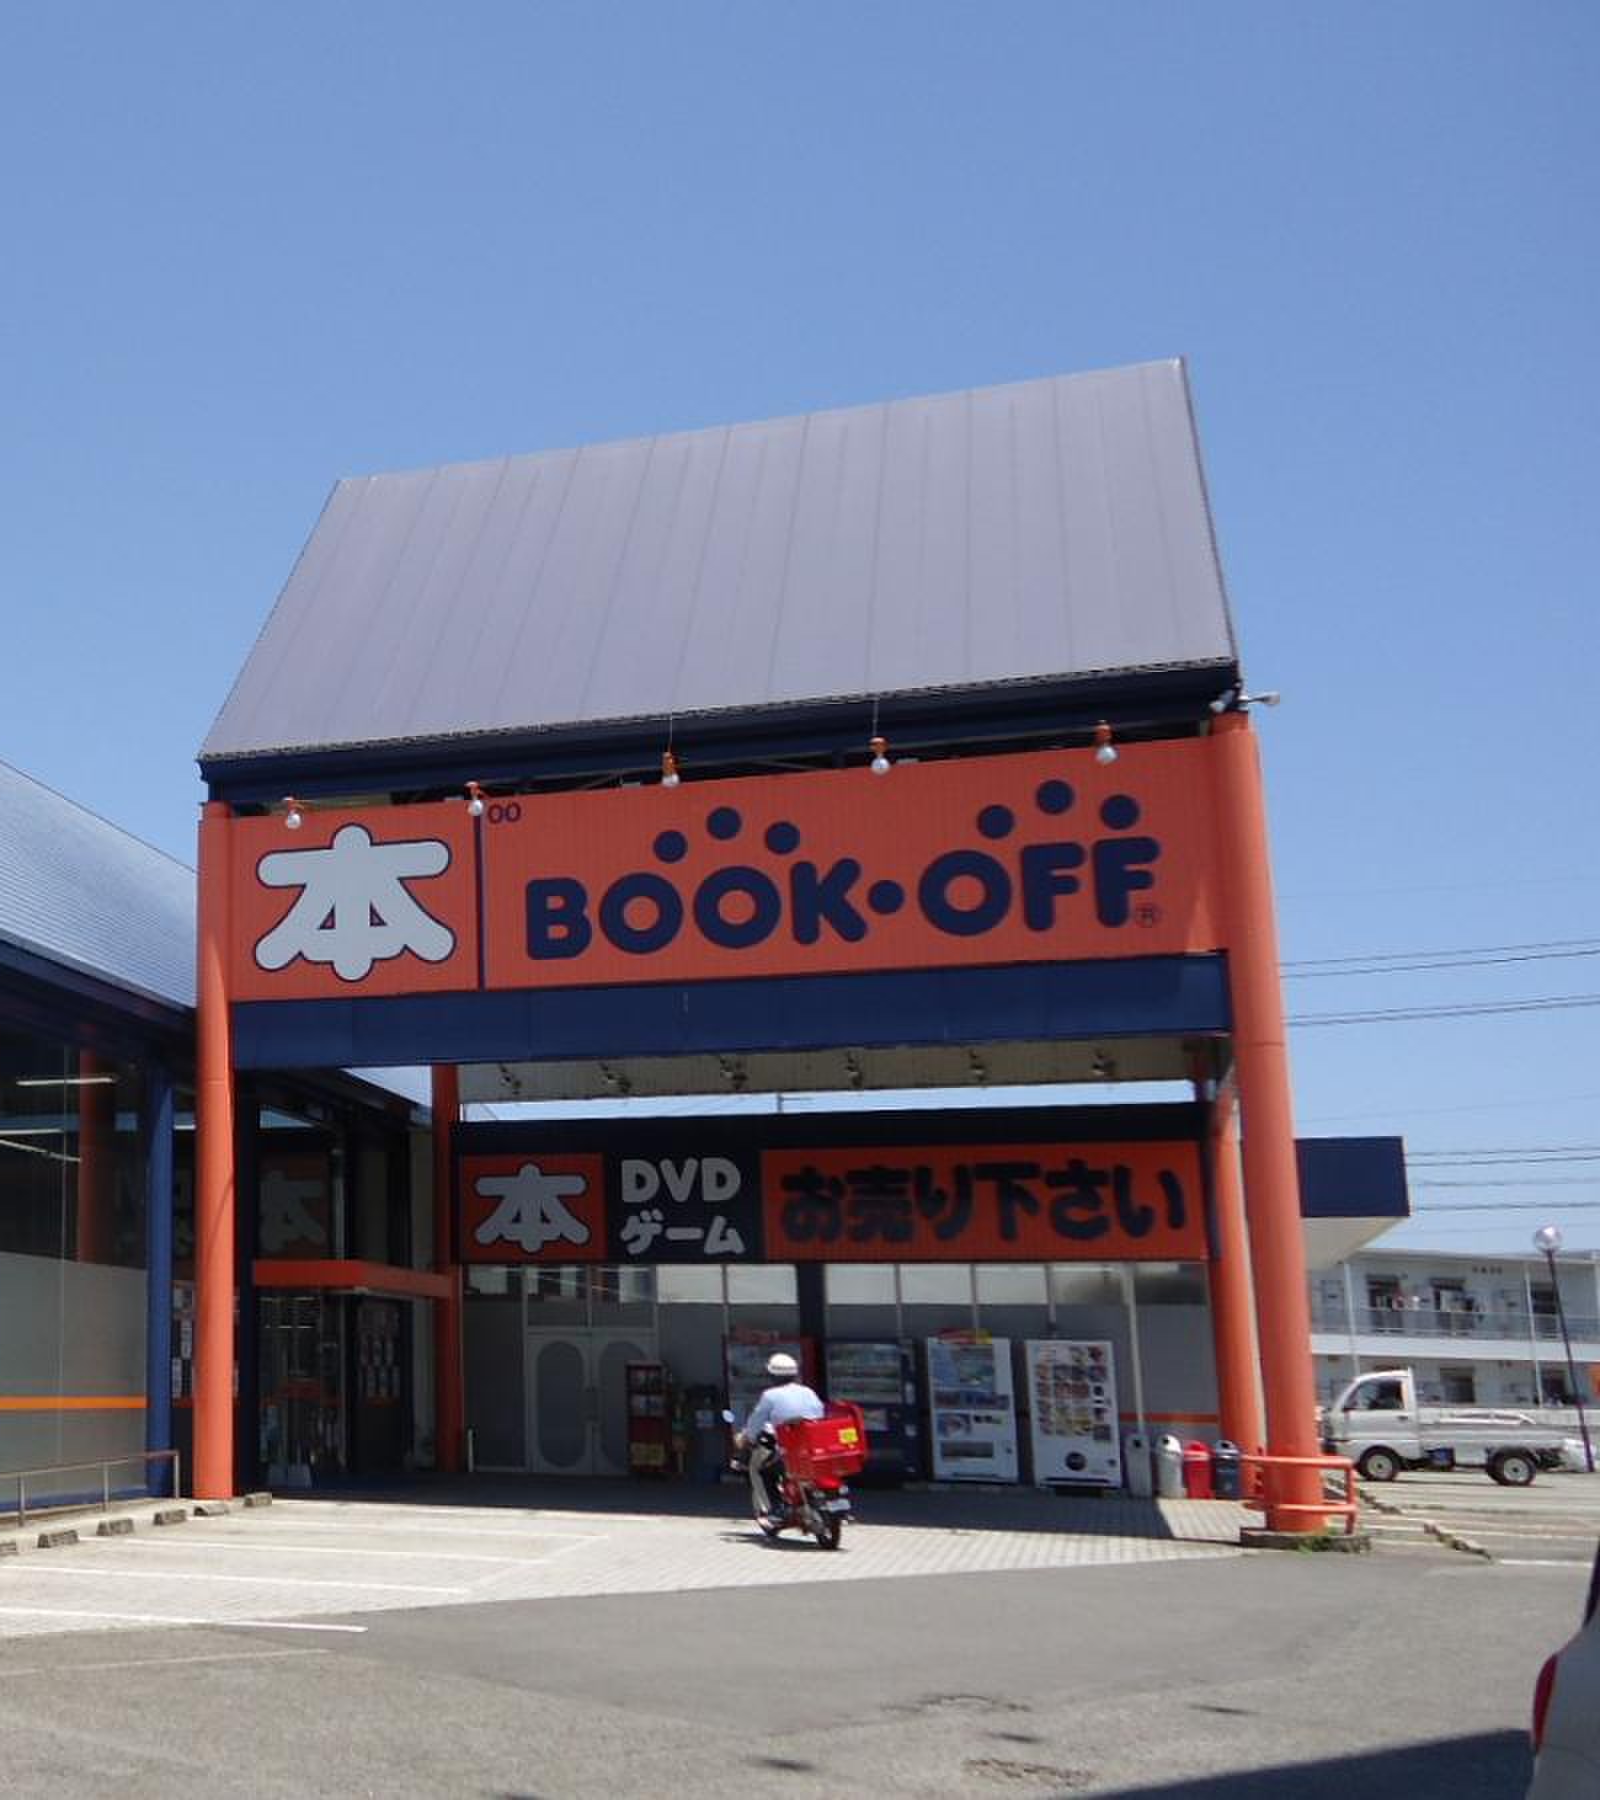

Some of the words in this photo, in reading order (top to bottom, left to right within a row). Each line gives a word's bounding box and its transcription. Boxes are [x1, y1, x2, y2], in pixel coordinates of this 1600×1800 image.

[255, 823, 456, 982] 本
[474, 1162, 590, 1254] 本
[620, 1156, 742, 1203] DVD
[780, 1158, 1186, 1242] お売り下さい
[620, 1208, 746, 1255] ゲーム
